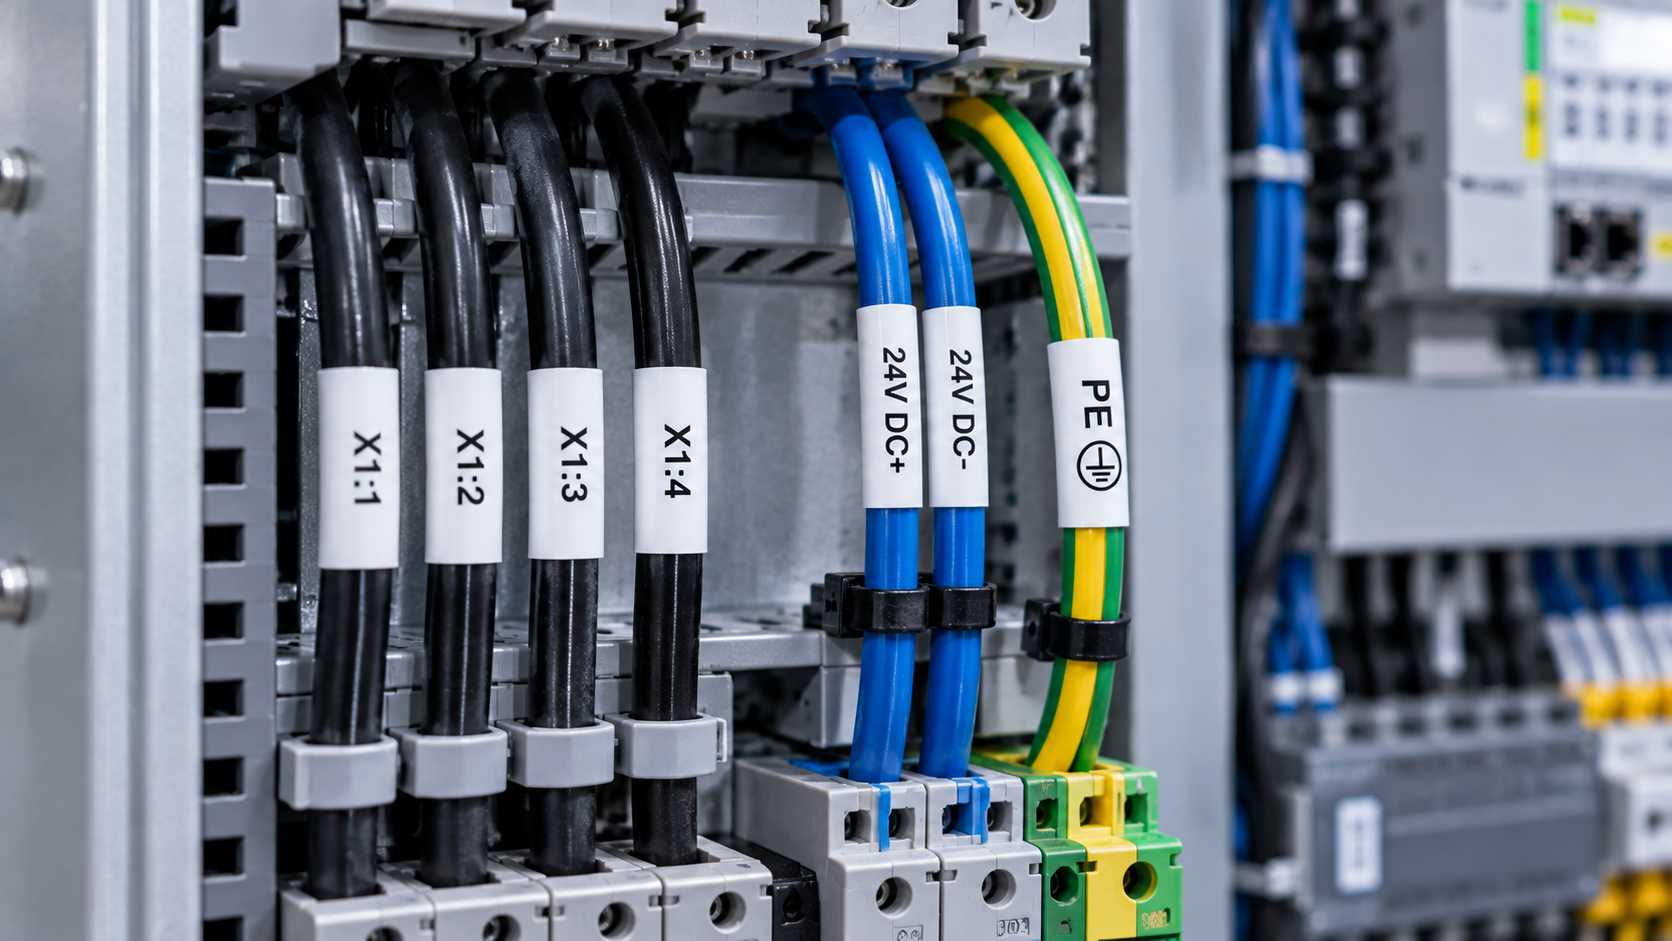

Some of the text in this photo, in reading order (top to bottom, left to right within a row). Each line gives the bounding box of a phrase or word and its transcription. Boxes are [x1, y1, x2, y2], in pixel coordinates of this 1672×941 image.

[883, 348, 908, 473] 24V DC+
[950, 350, 975, 469] 24V DC-
[1082, 380, 1112, 428] PE
[354, 432, 381, 504] X1:1
[457, 429, 484, 505] X1:2
[561, 427, 587, 502] X1:3
[665, 424, 691, 498] X1:4
